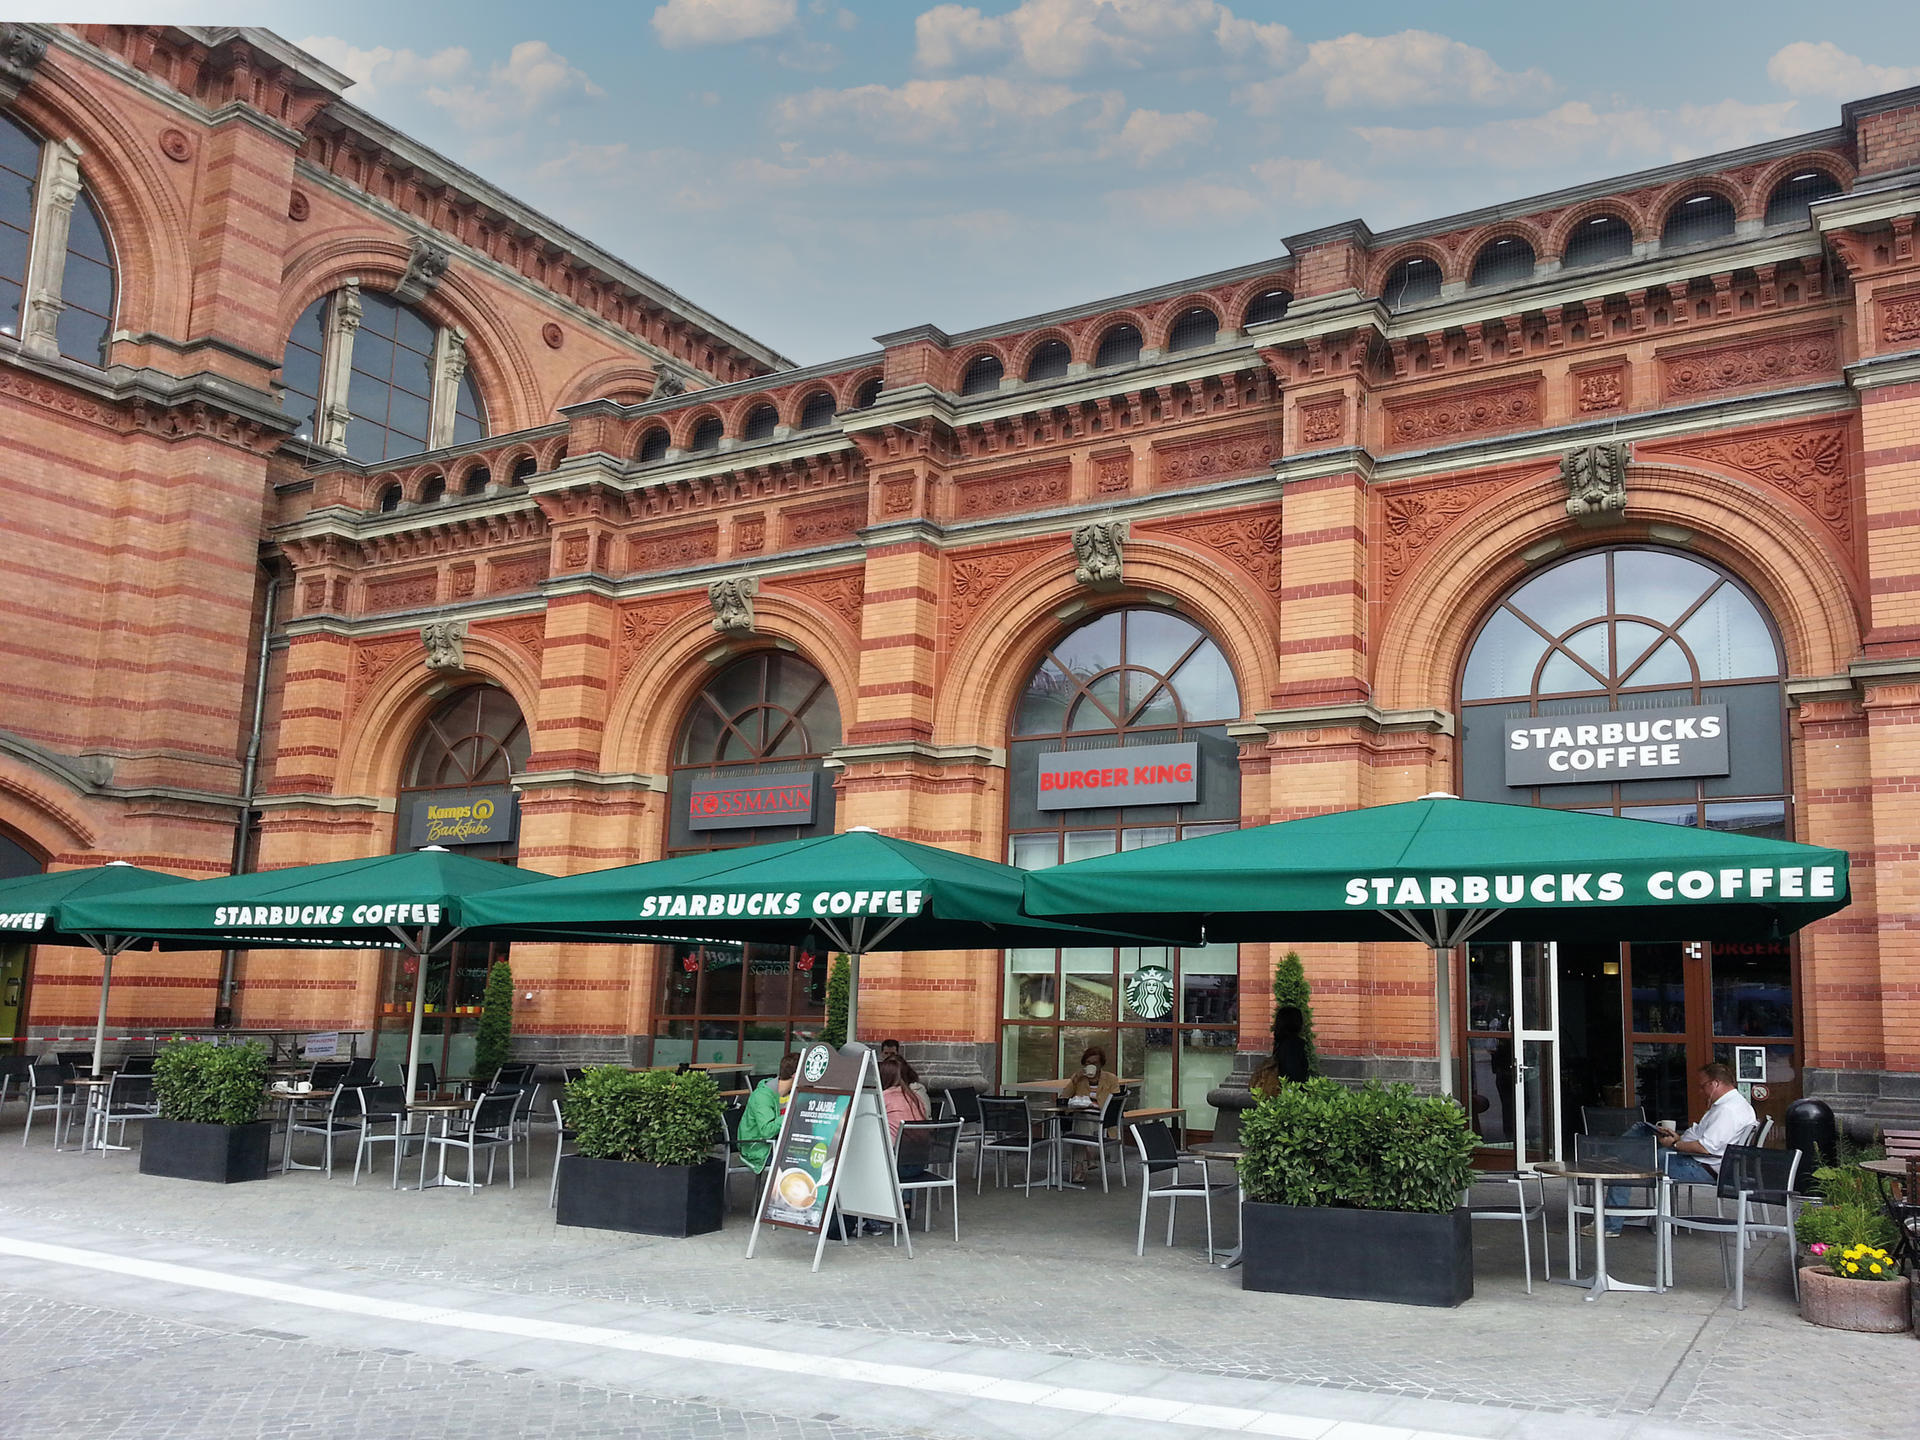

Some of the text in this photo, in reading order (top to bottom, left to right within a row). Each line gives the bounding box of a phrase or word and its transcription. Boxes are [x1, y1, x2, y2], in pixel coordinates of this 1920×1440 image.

[1510, 716, 1721, 750] STARBUCKS
[1548, 743, 1681, 772] COFFEE
[1040, 763, 1193, 791] BURGER KING
[427, 805, 471, 821] Kamps
[690, 788, 811, 814] ROSSMANN
[426, 819, 491, 841] Backstube
[1345, 867, 1835, 906] STARBUCKS COFFEE
[214, 904, 440, 926] STARBUCKS COFFEE
[640, 890, 922, 917] STARBUCKS COFFEE
[807, 1100, 816, 1111] 10
